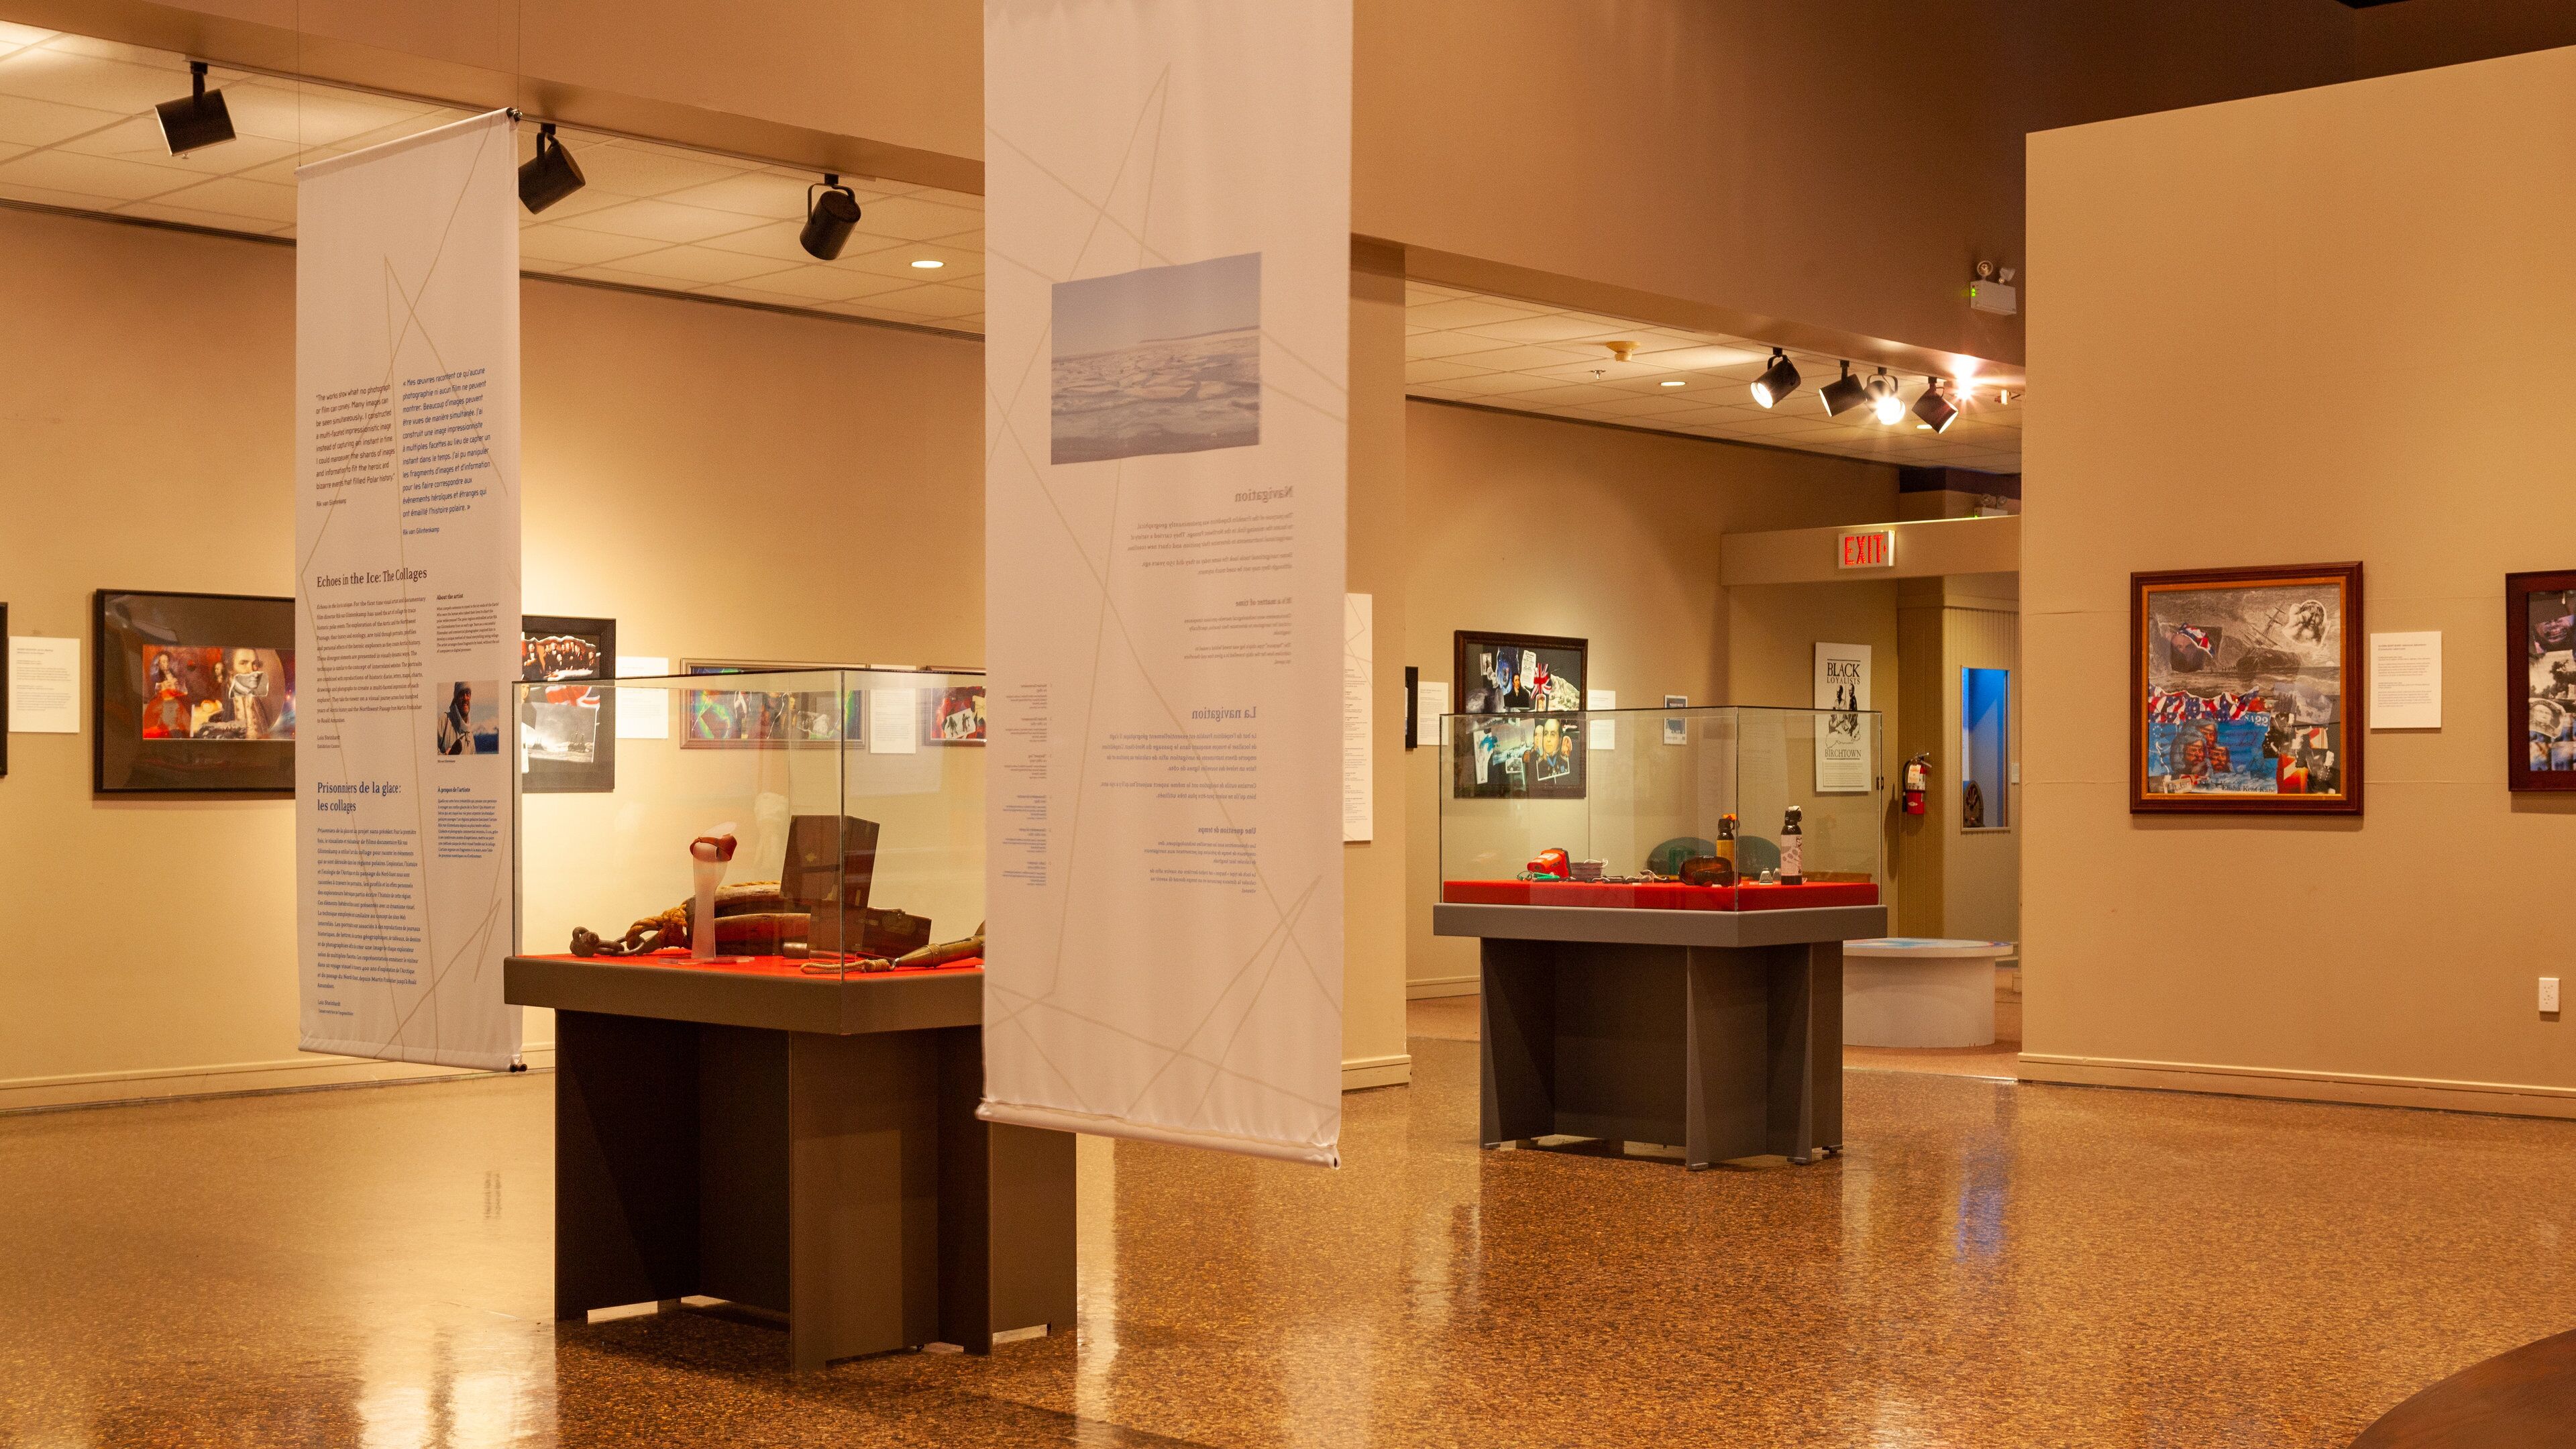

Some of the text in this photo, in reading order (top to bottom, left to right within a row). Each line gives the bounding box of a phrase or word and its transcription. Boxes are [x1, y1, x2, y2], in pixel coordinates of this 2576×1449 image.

[368, 384, 390, 395] photograph
[402, 390, 433, 401] photographie
[469, 380, 486, 391] peuvent
[366, 399, 380, 407] images
[423, 402, 444, 410] Beaucoup
[445, 398, 464, 407] d'images
[466, 394, 483, 405] peuvent
[368, 409, 391, 419] constructed
[432, 413, 449, 421] manière
[450, 409, 476, 419] simultanée.
[402, 431, 423, 439] construit
[447, 422, 483, 433] impressionniste
[407, 443, 427, 451] multiples
[470, 435, 484, 443] capter
[437, 453, 451, 462] temps.
[467, 447, 489, 457] manipuler
[410, 469, 434, 478] fragments
[435, 466, 453, 475] d'images
[461, 461, 490, 471] d'information
[402, 484, 413, 493] pour
[434, 478, 463, 488] correspondre
[460, 490, 478, 498] étranges
[429, 506, 448, 515] l'histoire
[449, 504, 466, 514] polaire.
[1845, 534, 1884, 565] EXIT
[317, 568, 427, 587] Echoes in the Ice: The Collages
[1827, 662, 1860, 677] BLACK
[2255, 715, 2268, 727] 22
[1825, 749, 1861, 757] BIRCHTOWN
[318, 782, 357, 793] Prisonniers
[359, 782, 370, 793] de
[372, 782, 380, 793] la
[318, 800, 356, 814] les collages
